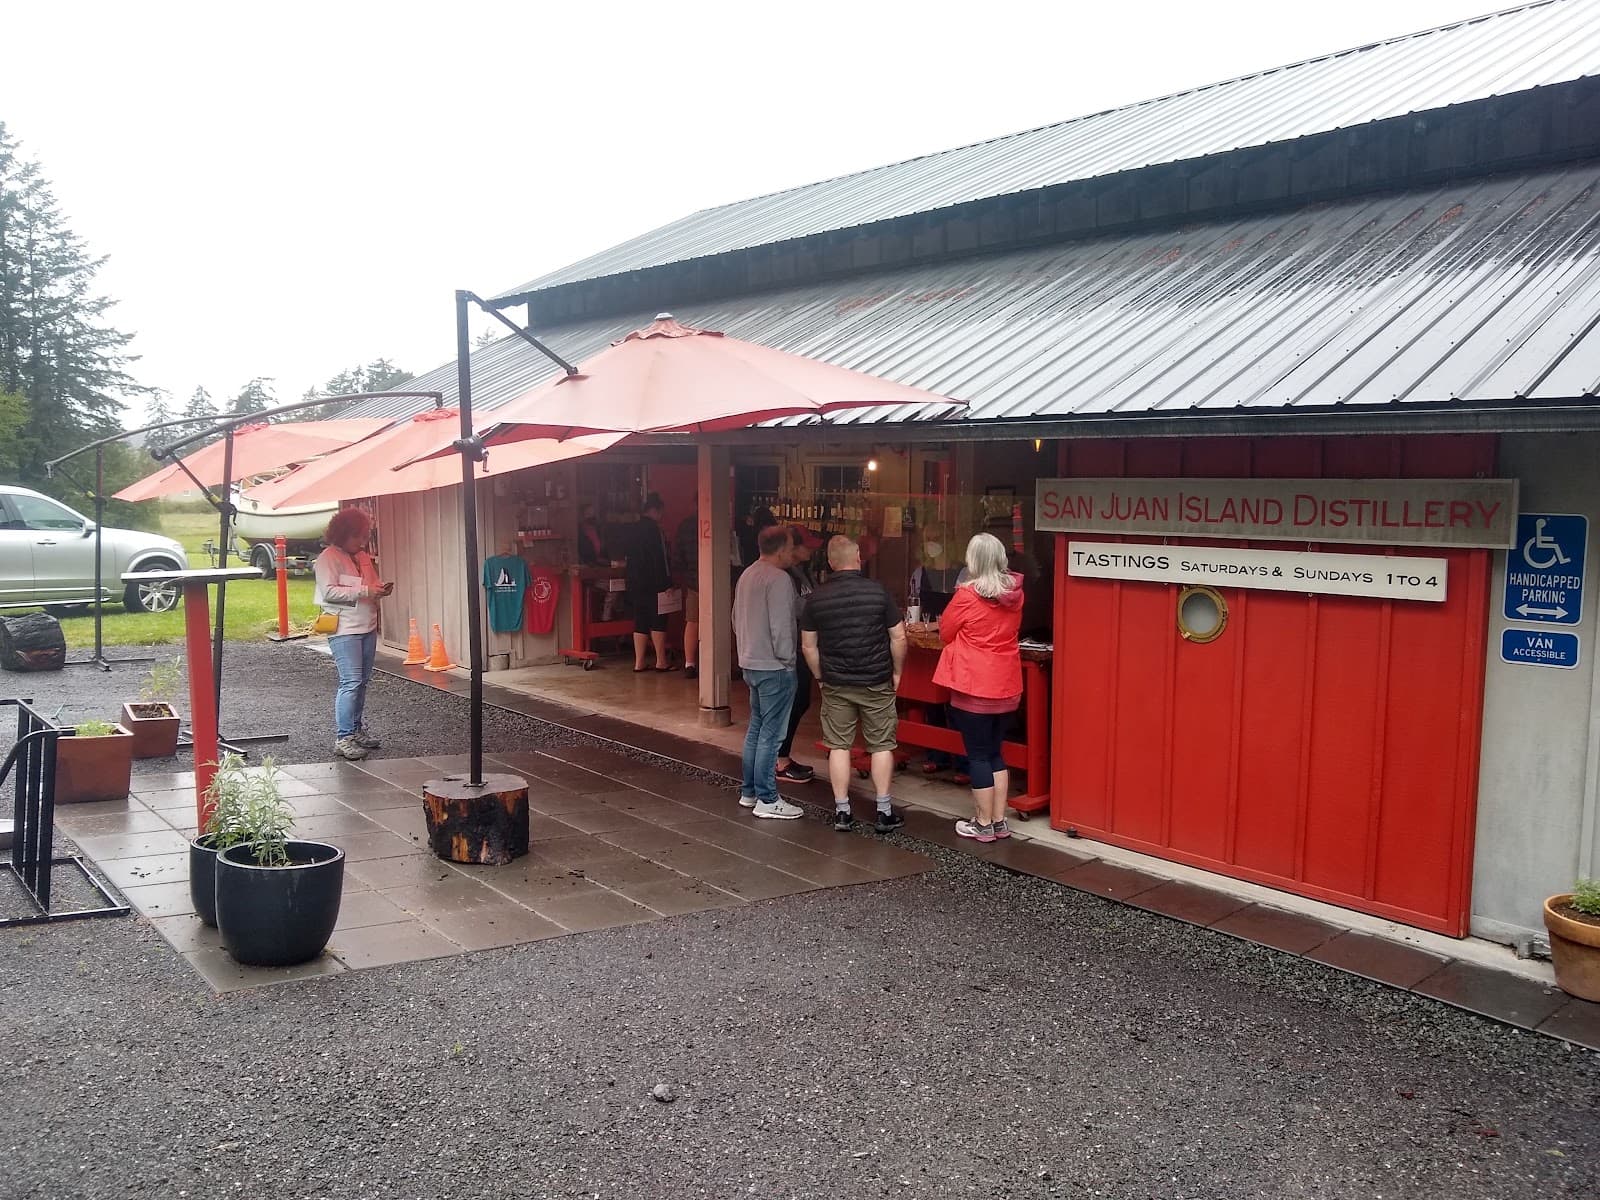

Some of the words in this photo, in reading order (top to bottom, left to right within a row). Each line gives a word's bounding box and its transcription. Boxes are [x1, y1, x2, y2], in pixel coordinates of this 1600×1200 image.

[1043, 491, 1093, 520] SAN
[1101, 492, 1169, 521] JUAN
[1178, 492, 1284, 525] ISLAND
[1293, 494, 1501, 529] DISTILLERY
[1072, 551, 1170, 570] TASTINGS
[1181, 561, 1268, 576] SATURDAYS
[1272, 566, 1283, 577] &
[1293, 567, 1373, 583] SUNDAYS
[1425, 576, 1438, 588] 4
[1509, 573, 1580, 590] HANDICAPPED
[1522, 589, 1566, 604] PARKING
[1527, 637, 1553, 649] VAN
[1513, 648, 1566, 660] ACCESSIBLE
